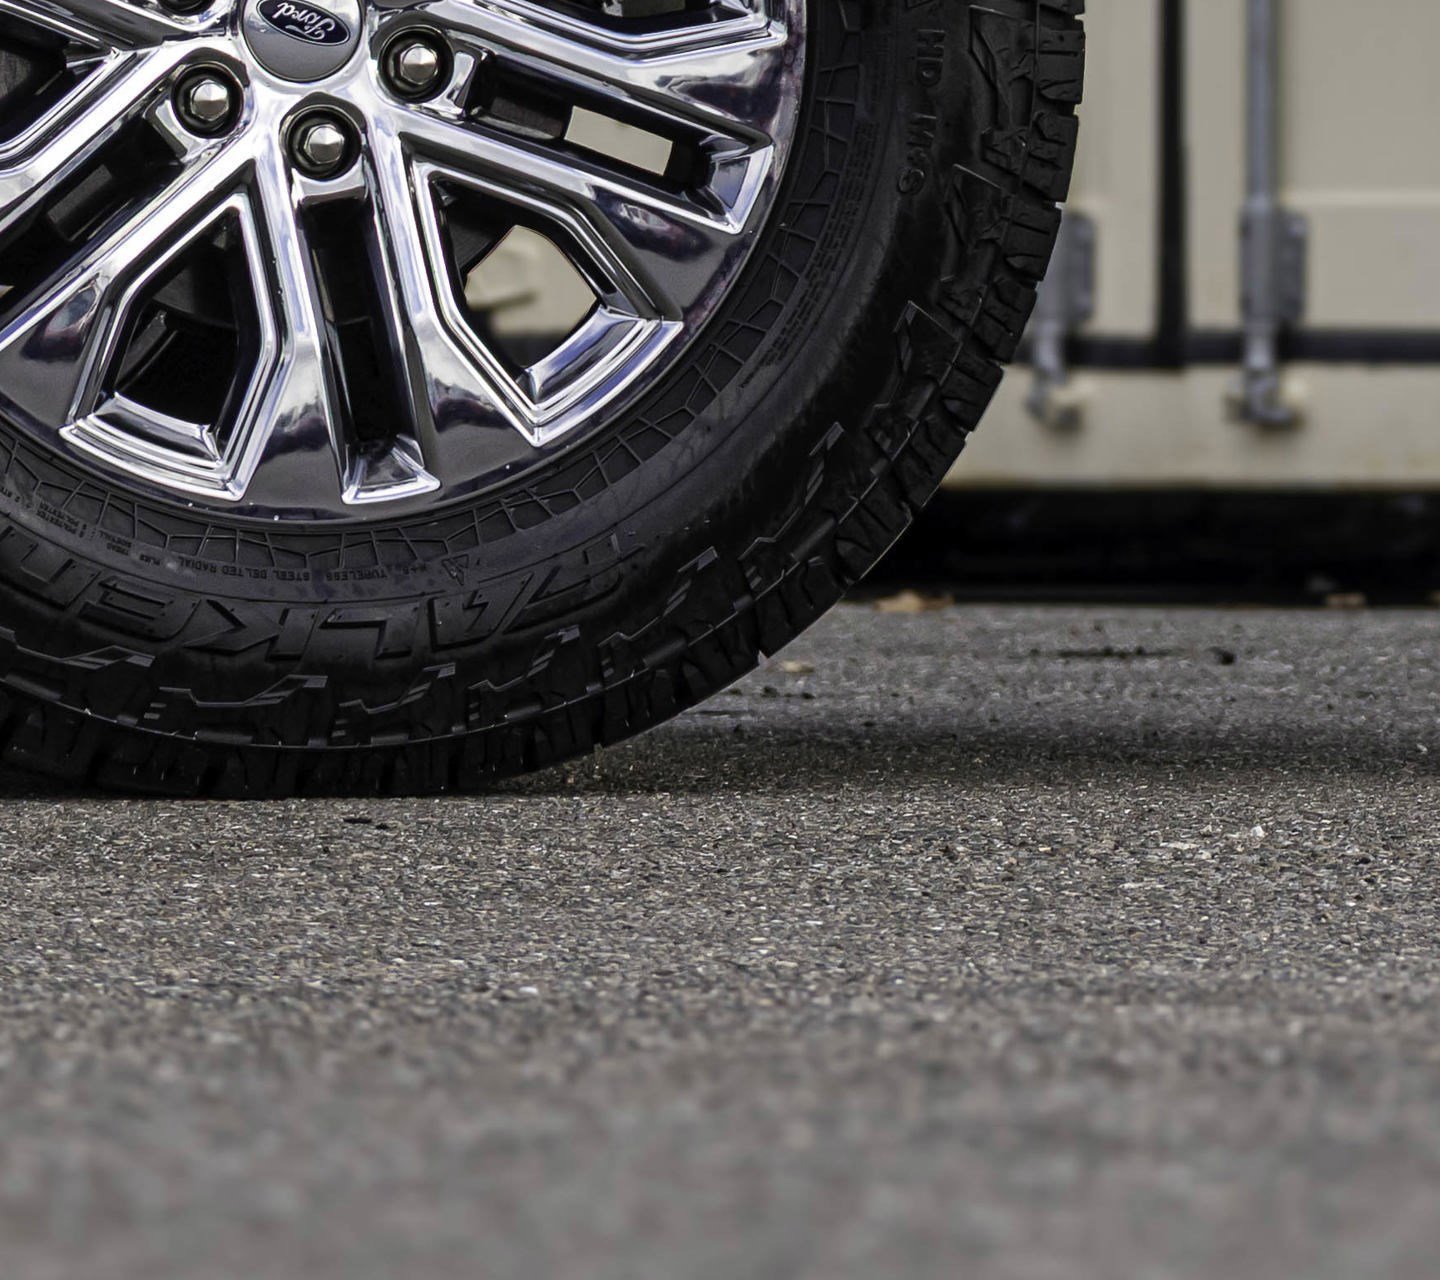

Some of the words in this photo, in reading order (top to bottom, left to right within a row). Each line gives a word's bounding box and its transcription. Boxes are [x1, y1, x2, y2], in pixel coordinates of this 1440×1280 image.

[270, 0, 338, 42] Ford
[176, 554, 217, 574] RADIAL
[218, 563, 267, 580] BELTED
[271, 569, 309, 582] STEEL
